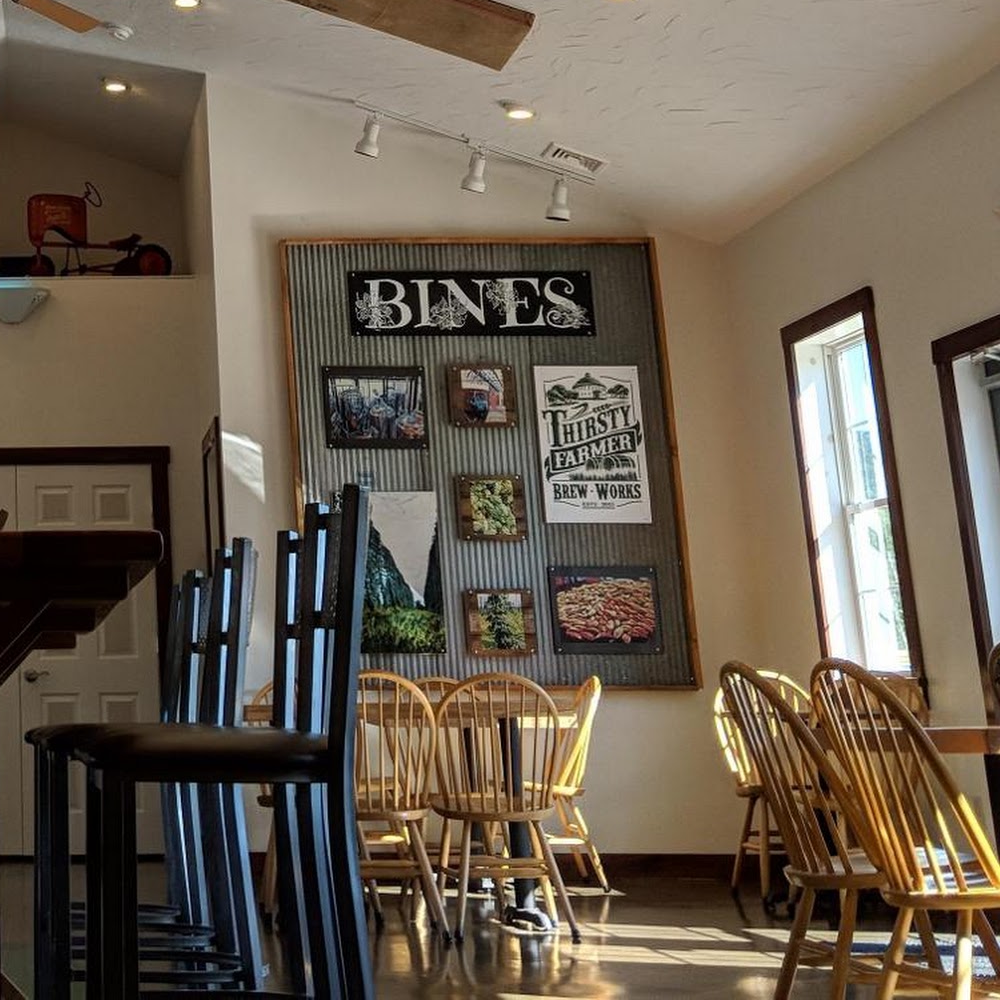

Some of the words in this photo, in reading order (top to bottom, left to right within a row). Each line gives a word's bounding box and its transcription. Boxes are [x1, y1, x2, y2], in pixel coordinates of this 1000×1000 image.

[358, 277, 589, 330] BINES
[542, 406, 631, 447] THIRSTY
[554, 433, 632, 468] FARMER
[553, 484, 588, 500] BREW
[595, 484, 641, 500] WORKS
